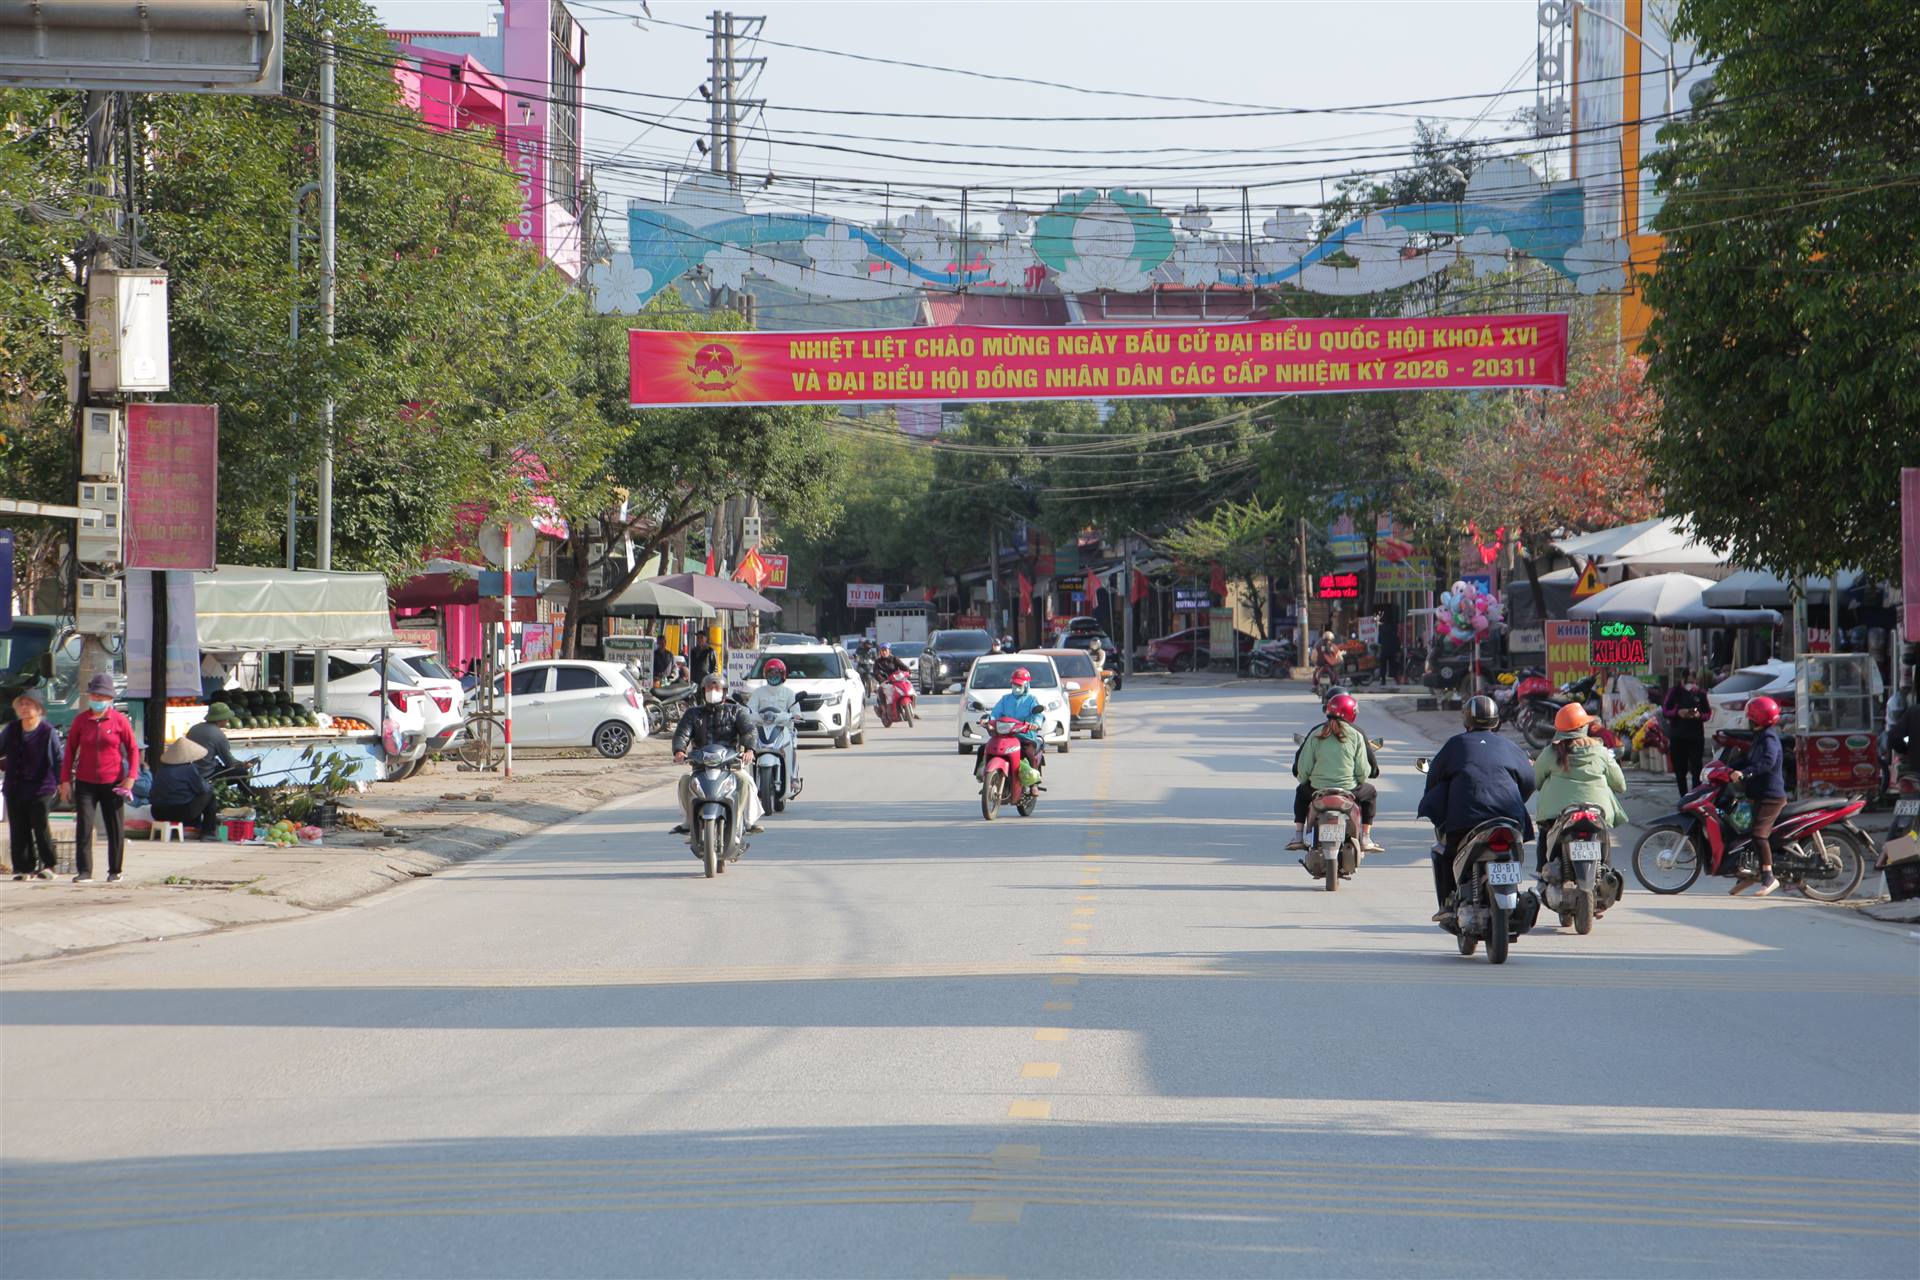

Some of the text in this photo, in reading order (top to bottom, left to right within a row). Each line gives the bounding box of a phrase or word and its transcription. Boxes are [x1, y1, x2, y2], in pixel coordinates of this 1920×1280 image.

[789, 325, 1538, 362] NHIỆT LIỆT CHÀO MỪNG NGÀY BẦU CỬ ĐẠI BIỂU QUỐC HỘI KHOÁ XVI
[791, 368, 821, 392] VÀ
[827, 371, 865, 397] ĐẠI
[872, 362, 924, 391] BIỂU
[931, 367, 969, 394] HỘI
[975, 364, 1038, 389] ĐỒNG
[1045, 364, 1109, 388] NHÂN
[1116, 363, 1163, 387] DÂN
[1170, 363, 1216, 385] CÁC
[1223, 357, 1269, 385] CẤP
[1275, 360, 1350, 383] NHIỆM
[1357, 359, 1386, 381] KỲ
[1393, 360, 1449, 380] 2026
[1472, 358, 1536, 378] 2031!
[1601, 622, 1636, 637] SỬA
[1593, 636, 1645, 663] KHÓA
